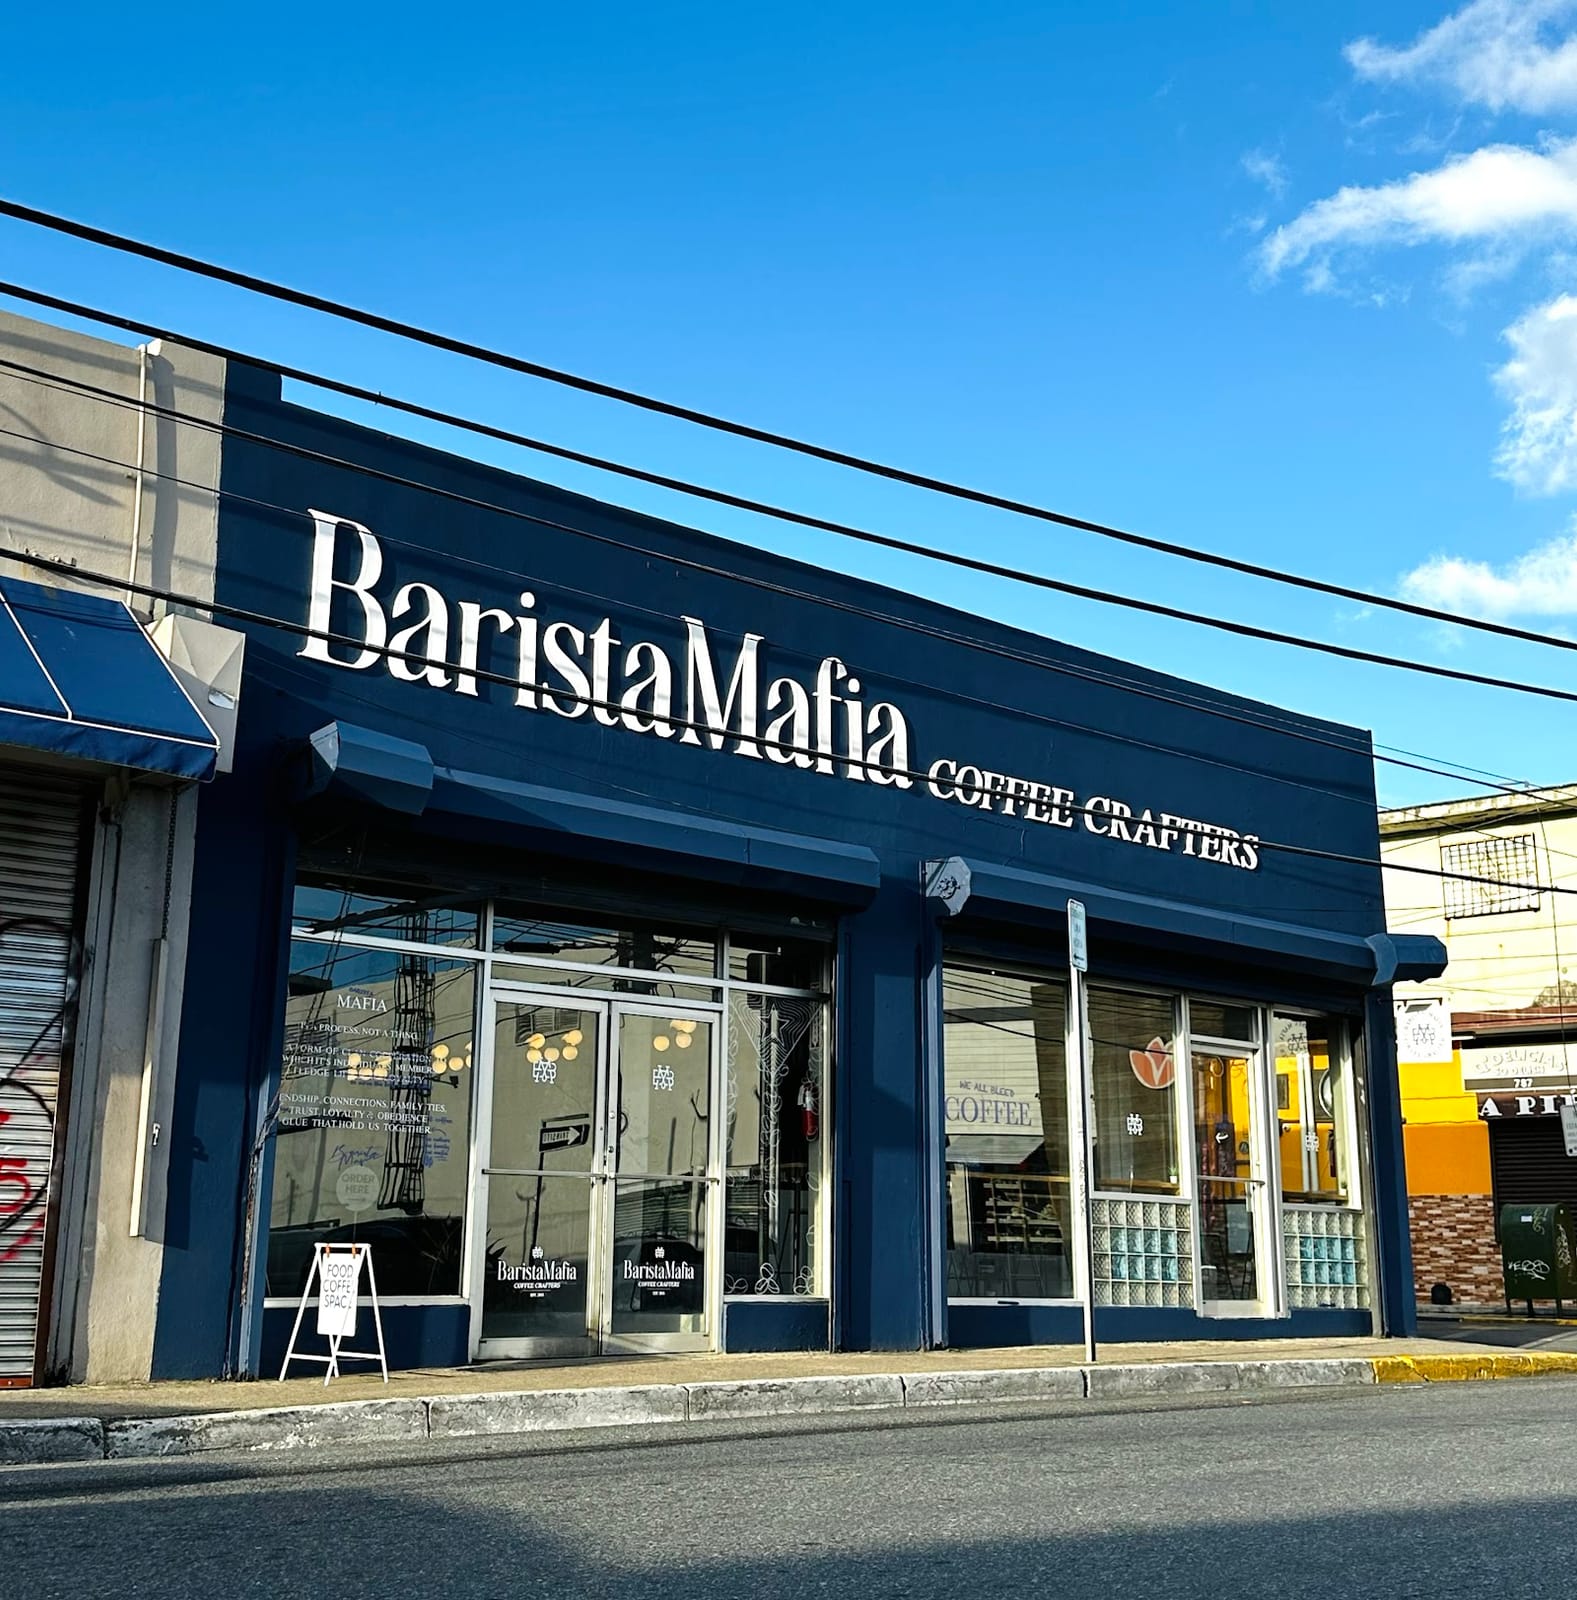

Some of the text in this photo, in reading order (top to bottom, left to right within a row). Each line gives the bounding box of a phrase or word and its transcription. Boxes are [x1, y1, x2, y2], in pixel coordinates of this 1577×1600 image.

[928, 759, 1074, 828] COFFEE
[1084, 796, 1259, 871] CRAFTERS
[337, 994, 387, 1012] MAFIA
[362, 1027, 382, 1037] NOT
[383, 1030, 390, 1038] A
[391, 1030, 418, 1041] THING
[960, 1080, 972, 1090] WE
[974, 1081, 988, 1093] ALL
[1513, 1079, 1533, 1088] 787
[390, 1100, 423, 1112] FAMILY
[945, 1096, 1032, 1126] COFFEE
[323, 1108, 364, 1119] LOYALTY
[378, 1111, 428, 1123] OBEDIENCE
[282, 1117, 309, 1127] GLUE
[312, 1119, 337, 1128] THAT
[338, 1120, 365, 1130] HOLD
[368, 1121, 379, 1131] US
[341, 1173, 375, 1184] ORDER
[345, 1184, 369, 1194] HERE
[327, 1264, 354, 1278] FOOD
[497, 1259, 577, 1281] BaristaMafia
[623, 1259, 695, 1281] BaristaMafia
[323, 1279, 353, 1293] COFFE
[324, 1294, 352, 1309] SPAC
